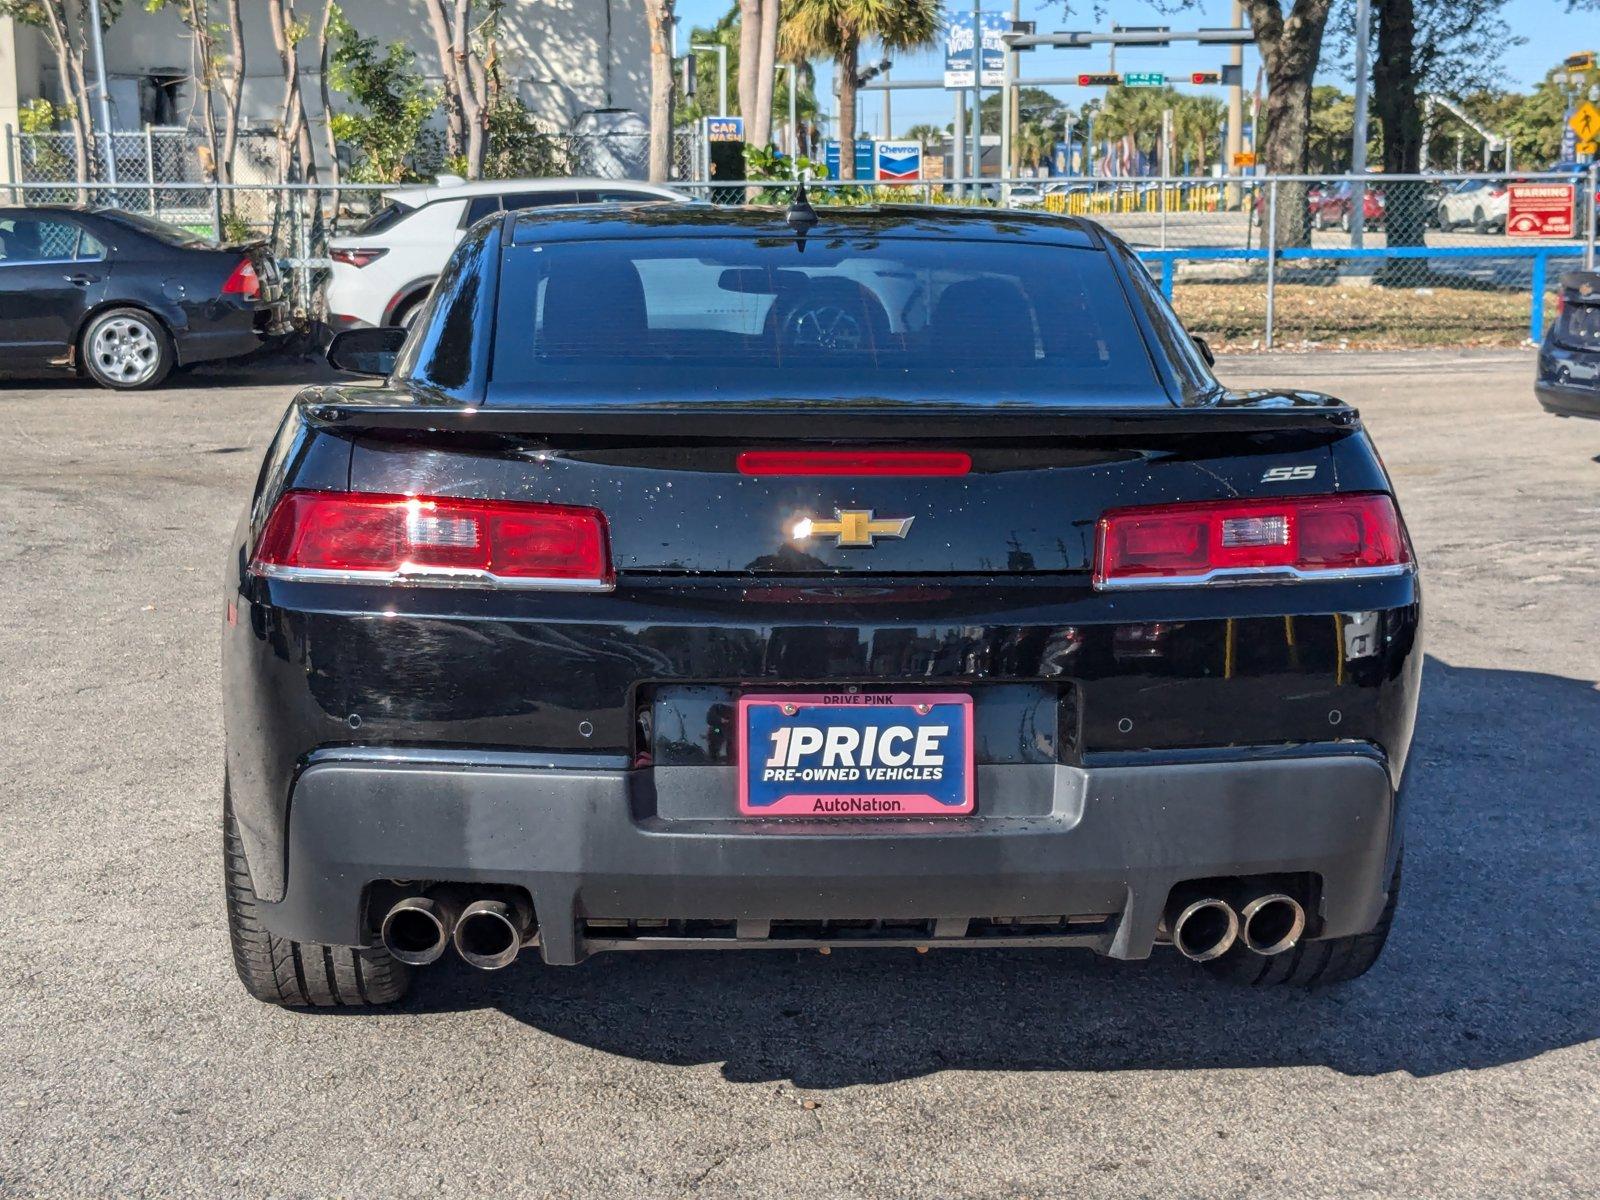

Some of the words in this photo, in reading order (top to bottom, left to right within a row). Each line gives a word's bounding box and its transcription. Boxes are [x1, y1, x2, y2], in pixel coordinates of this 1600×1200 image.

[711, 122, 737, 133] CAR
[879, 144, 920, 155] Chevron
[1513, 187, 1570, 198] WARNING
[1260, 465, 1318, 483] SS
[823, 695, 861, 705] DRIVE
[864, 695, 894, 705] PINK
[763, 768, 860, 782] PRE-OWNED
[866, 767, 943, 780] VEHICLES
[812, 798, 902, 812] AutoNation
